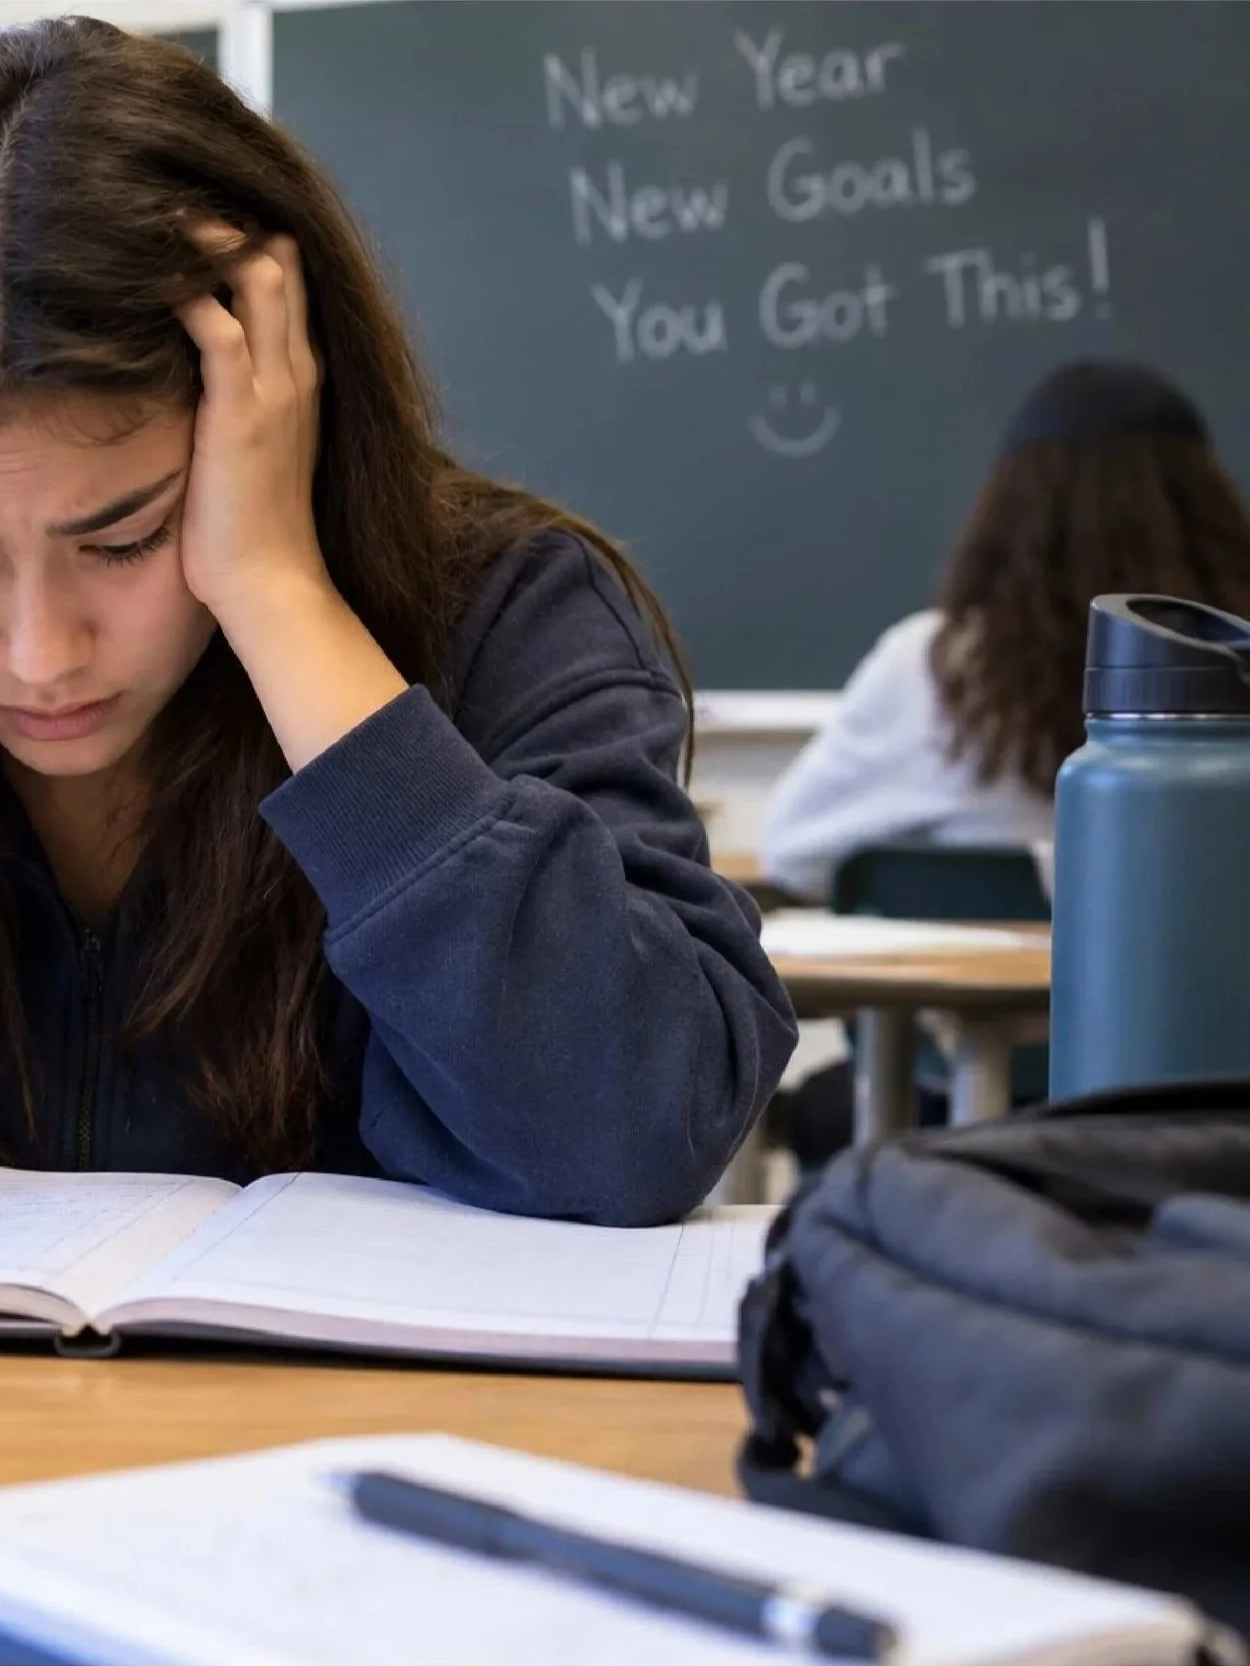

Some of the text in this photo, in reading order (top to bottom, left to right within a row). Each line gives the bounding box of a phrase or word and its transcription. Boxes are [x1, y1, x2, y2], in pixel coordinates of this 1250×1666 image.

[543, 25, 906, 129] New Year
[570, 125, 977, 246] New Goals
[590, 217, 1112, 365] You Got This!
